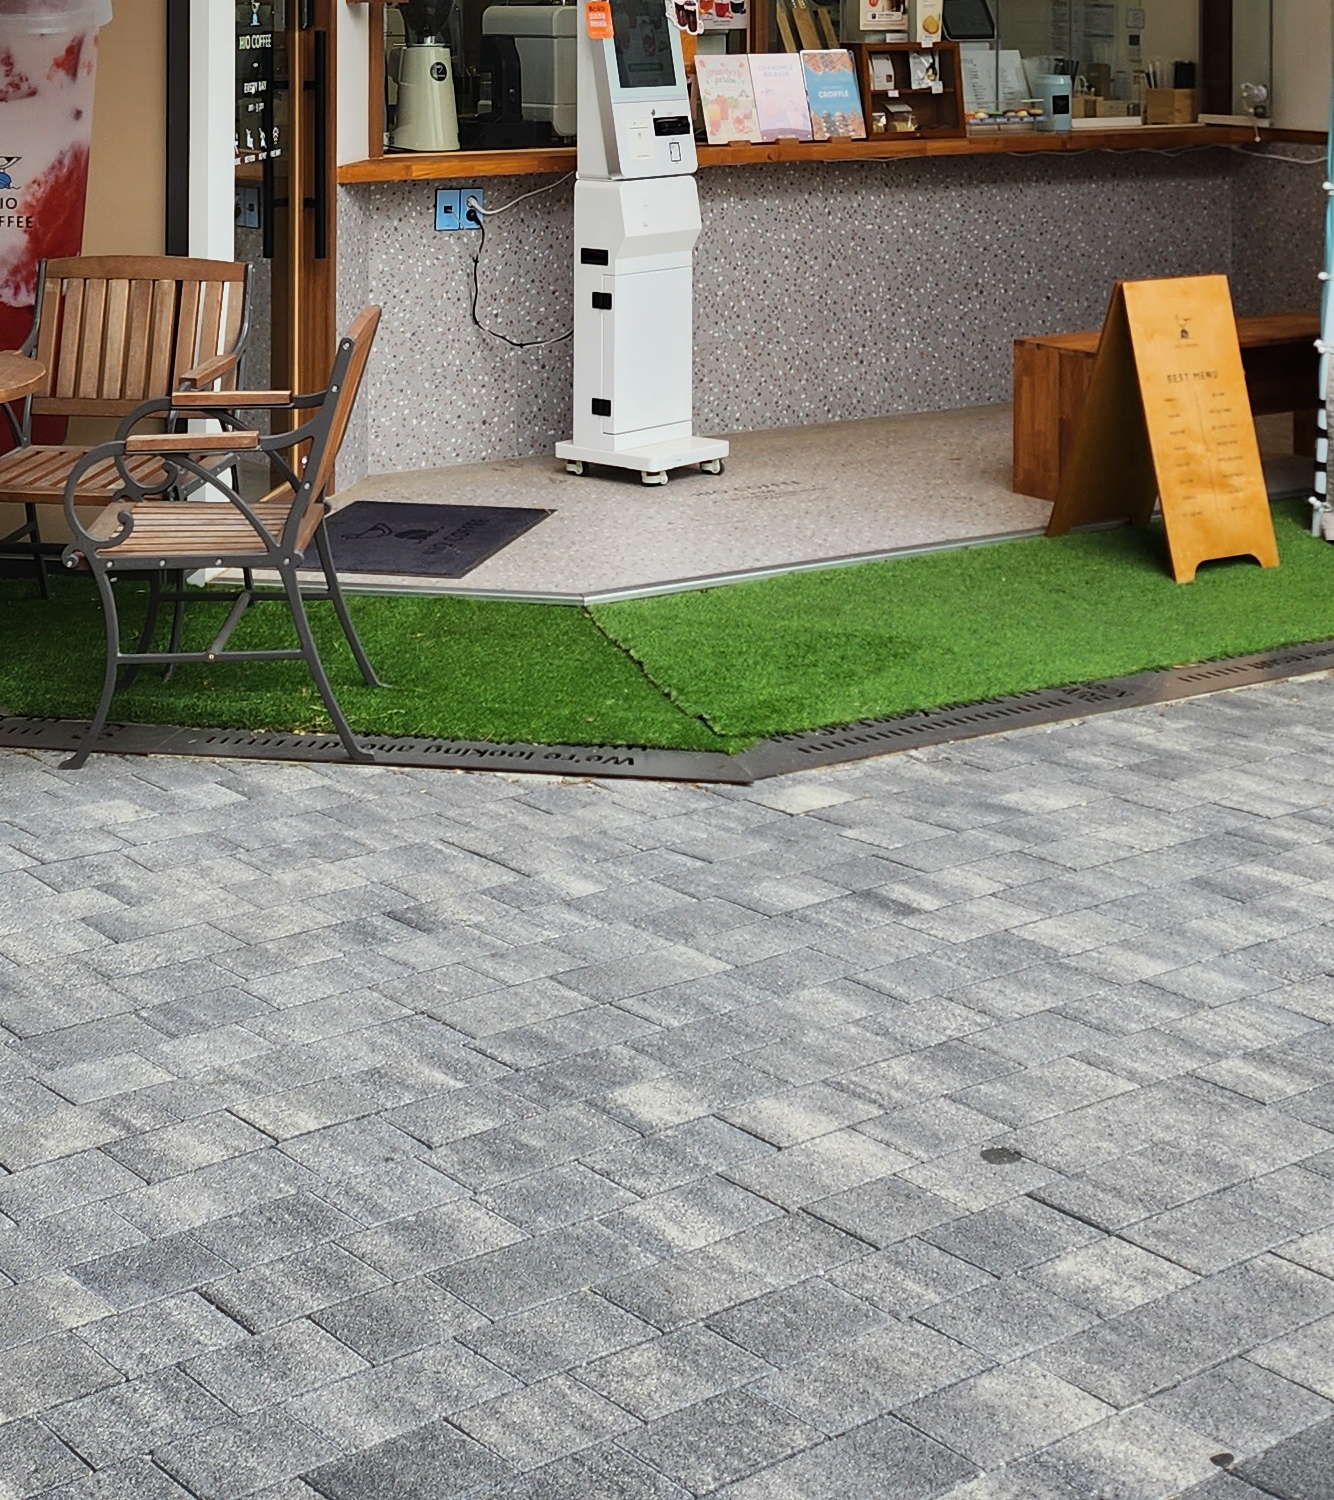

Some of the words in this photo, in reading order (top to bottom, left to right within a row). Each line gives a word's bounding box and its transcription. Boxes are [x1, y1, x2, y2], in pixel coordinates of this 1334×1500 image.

[252, 34, 272, 48] COFFEE
[1167, 373, 1190, 384] BEST
[1193, 369, 1219, 381] MENU
[317, 741, 415, 755] ahed
[423, 744, 535, 761] looking
[543, 751, 635, 767] We're
